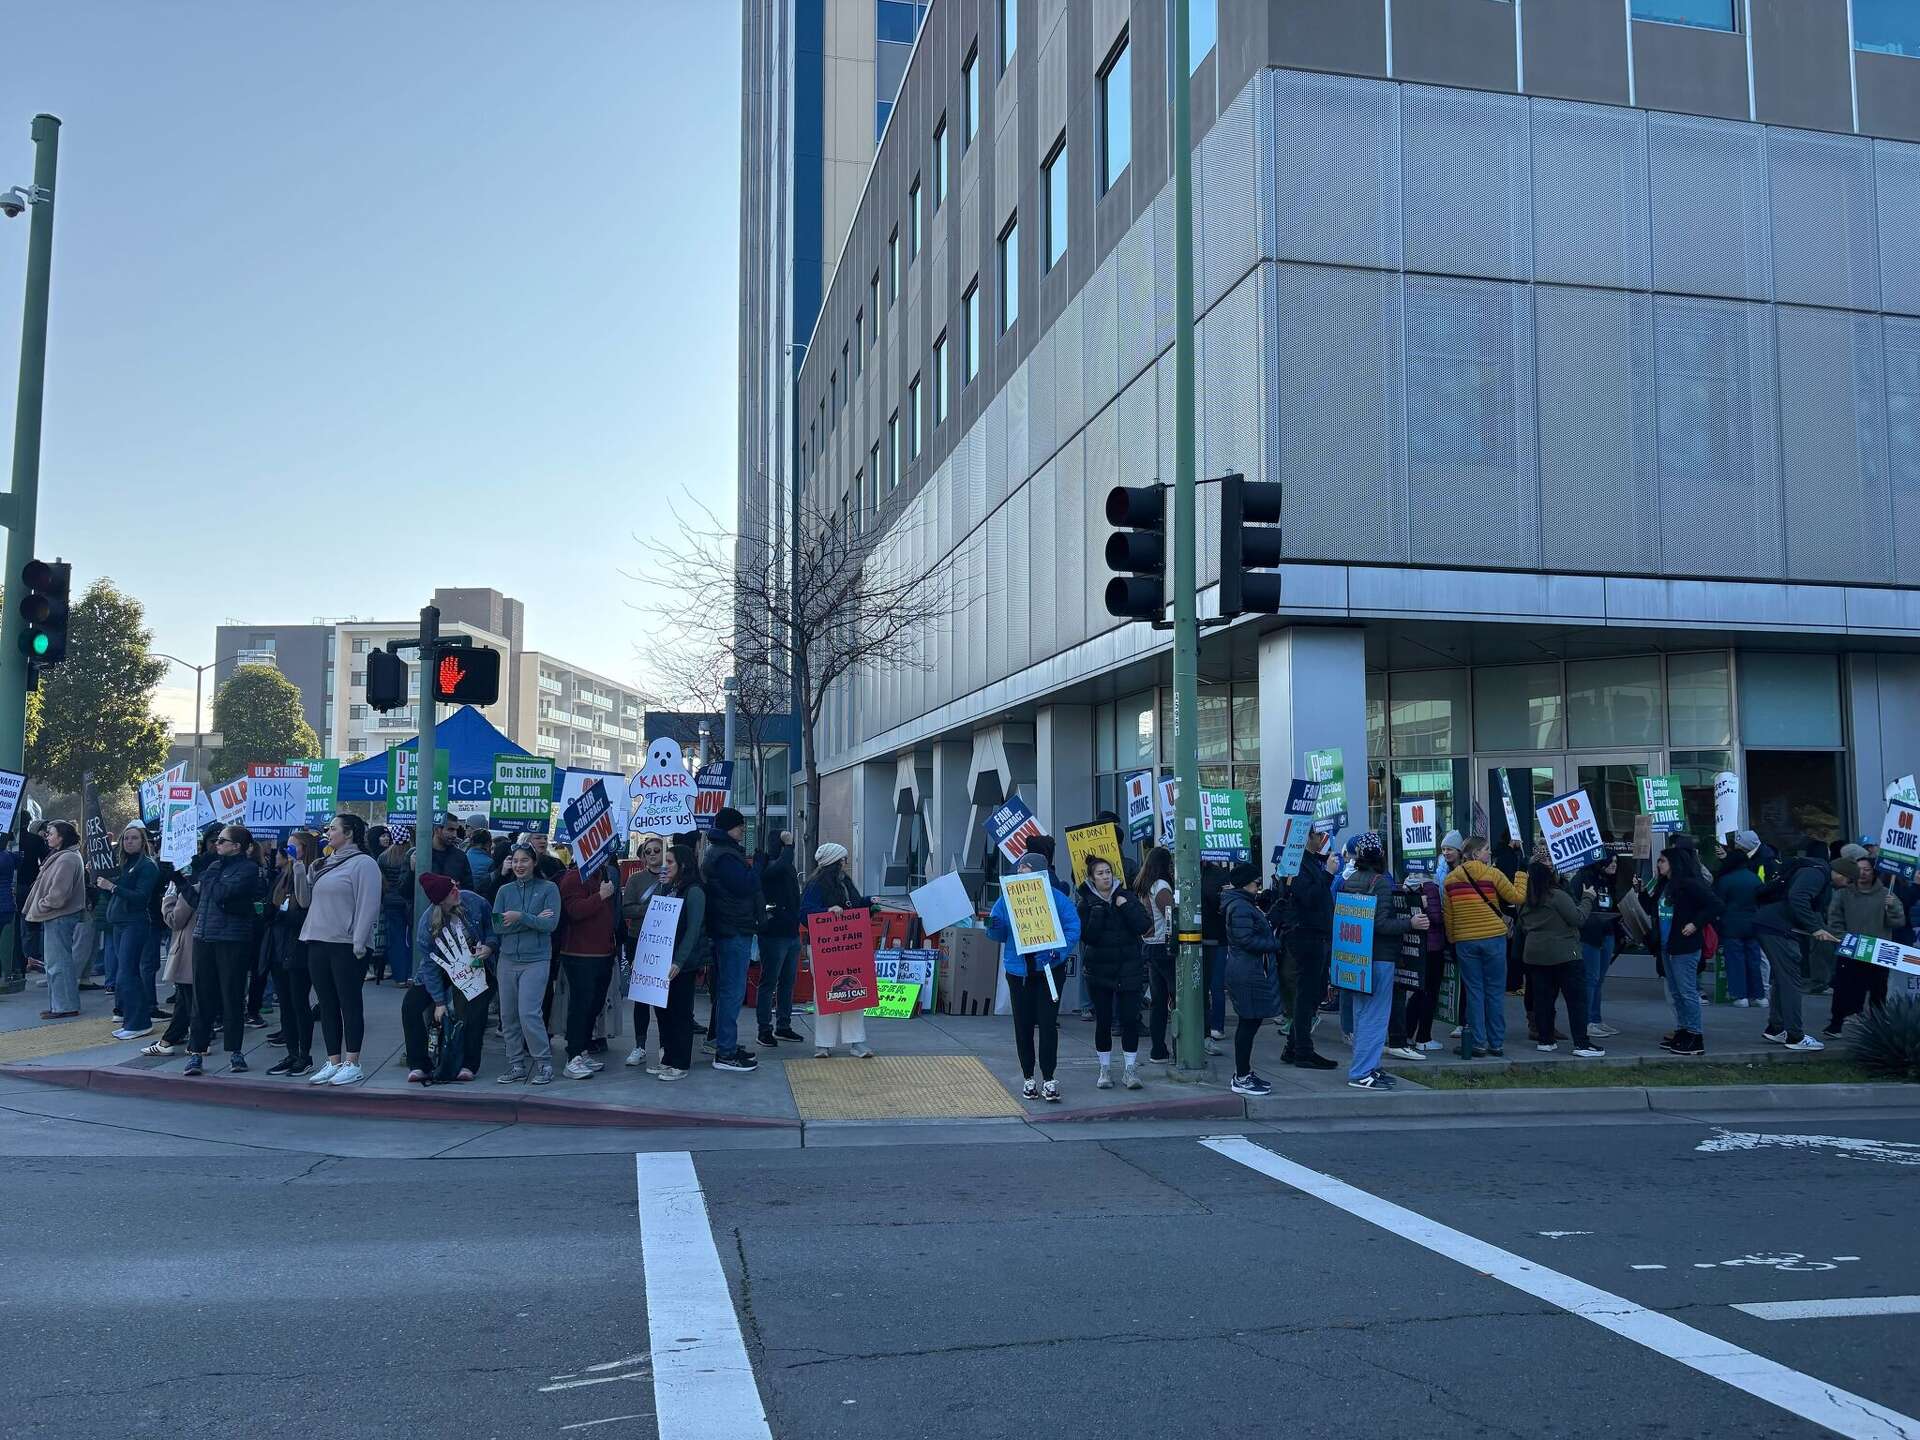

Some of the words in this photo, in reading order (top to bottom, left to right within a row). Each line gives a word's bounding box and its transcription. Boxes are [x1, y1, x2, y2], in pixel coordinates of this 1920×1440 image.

[255, 766, 272, 777] ULP
[274, 766, 303, 777] STRIKE
[500, 766, 514, 778] On
[515, 766, 546, 778] Strike
[707, 764, 723, 776] FAIR
[640, 773, 689, 789] KAISER
[698, 776, 728, 787] CONTRACT
[172, 789, 190, 797] NOTICE
[254, 782, 295, 800] HONK
[503, 786, 521, 796] FOR
[523, 786, 541, 797] OUR
[1202, 792, 1230, 804] Unfair
[493, 798, 548, 814] PATIENTS
[577, 791, 595, 815] FAIR
[694, 790, 727, 814] NOW
[1130, 797, 1150, 818] STRIKE
[1317, 799, 1342, 818] STRIKE
[252, 801, 297, 822] HONK
[574, 798, 604, 833] CONTRACT
[994, 806, 1013, 826] FAIR
[1411, 804, 1425, 824] ON
[1547, 797, 1581, 829] ULP
[635, 815, 672, 828] GHOSTS
[676, 813, 692, 826] US!
[996, 810, 1025, 839] CONTRACT
[1204, 818, 1243, 830] Practice
[1898, 811, 1914, 831] ON
[577, 812, 613, 862] NOW
[1004, 819, 1041, 860] NOW
[1205, 833, 1243, 849] STRIKE
[1405, 826, 1432, 844] STRIKE
[1886, 829, 1918, 850] STRIKE
[89, 835, 111, 852] LOST
[1551, 827, 1599, 861] STRIKE
[91, 851, 115, 870] WAY
[651, 900, 677, 913] INVEST
[653, 920, 662, 928] IN
[839, 912, 861, 921] hold
[833, 925, 848, 933] out
[640, 931, 673, 947] PATIENTS
[817, 935, 831, 945] for
[842, 932, 863, 942] FAIR
[821, 943, 863, 954] contract?
[643, 953, 661, 965] NOT
[826, 969, 844, 977] You
[846, 967, 862, 976] bet
